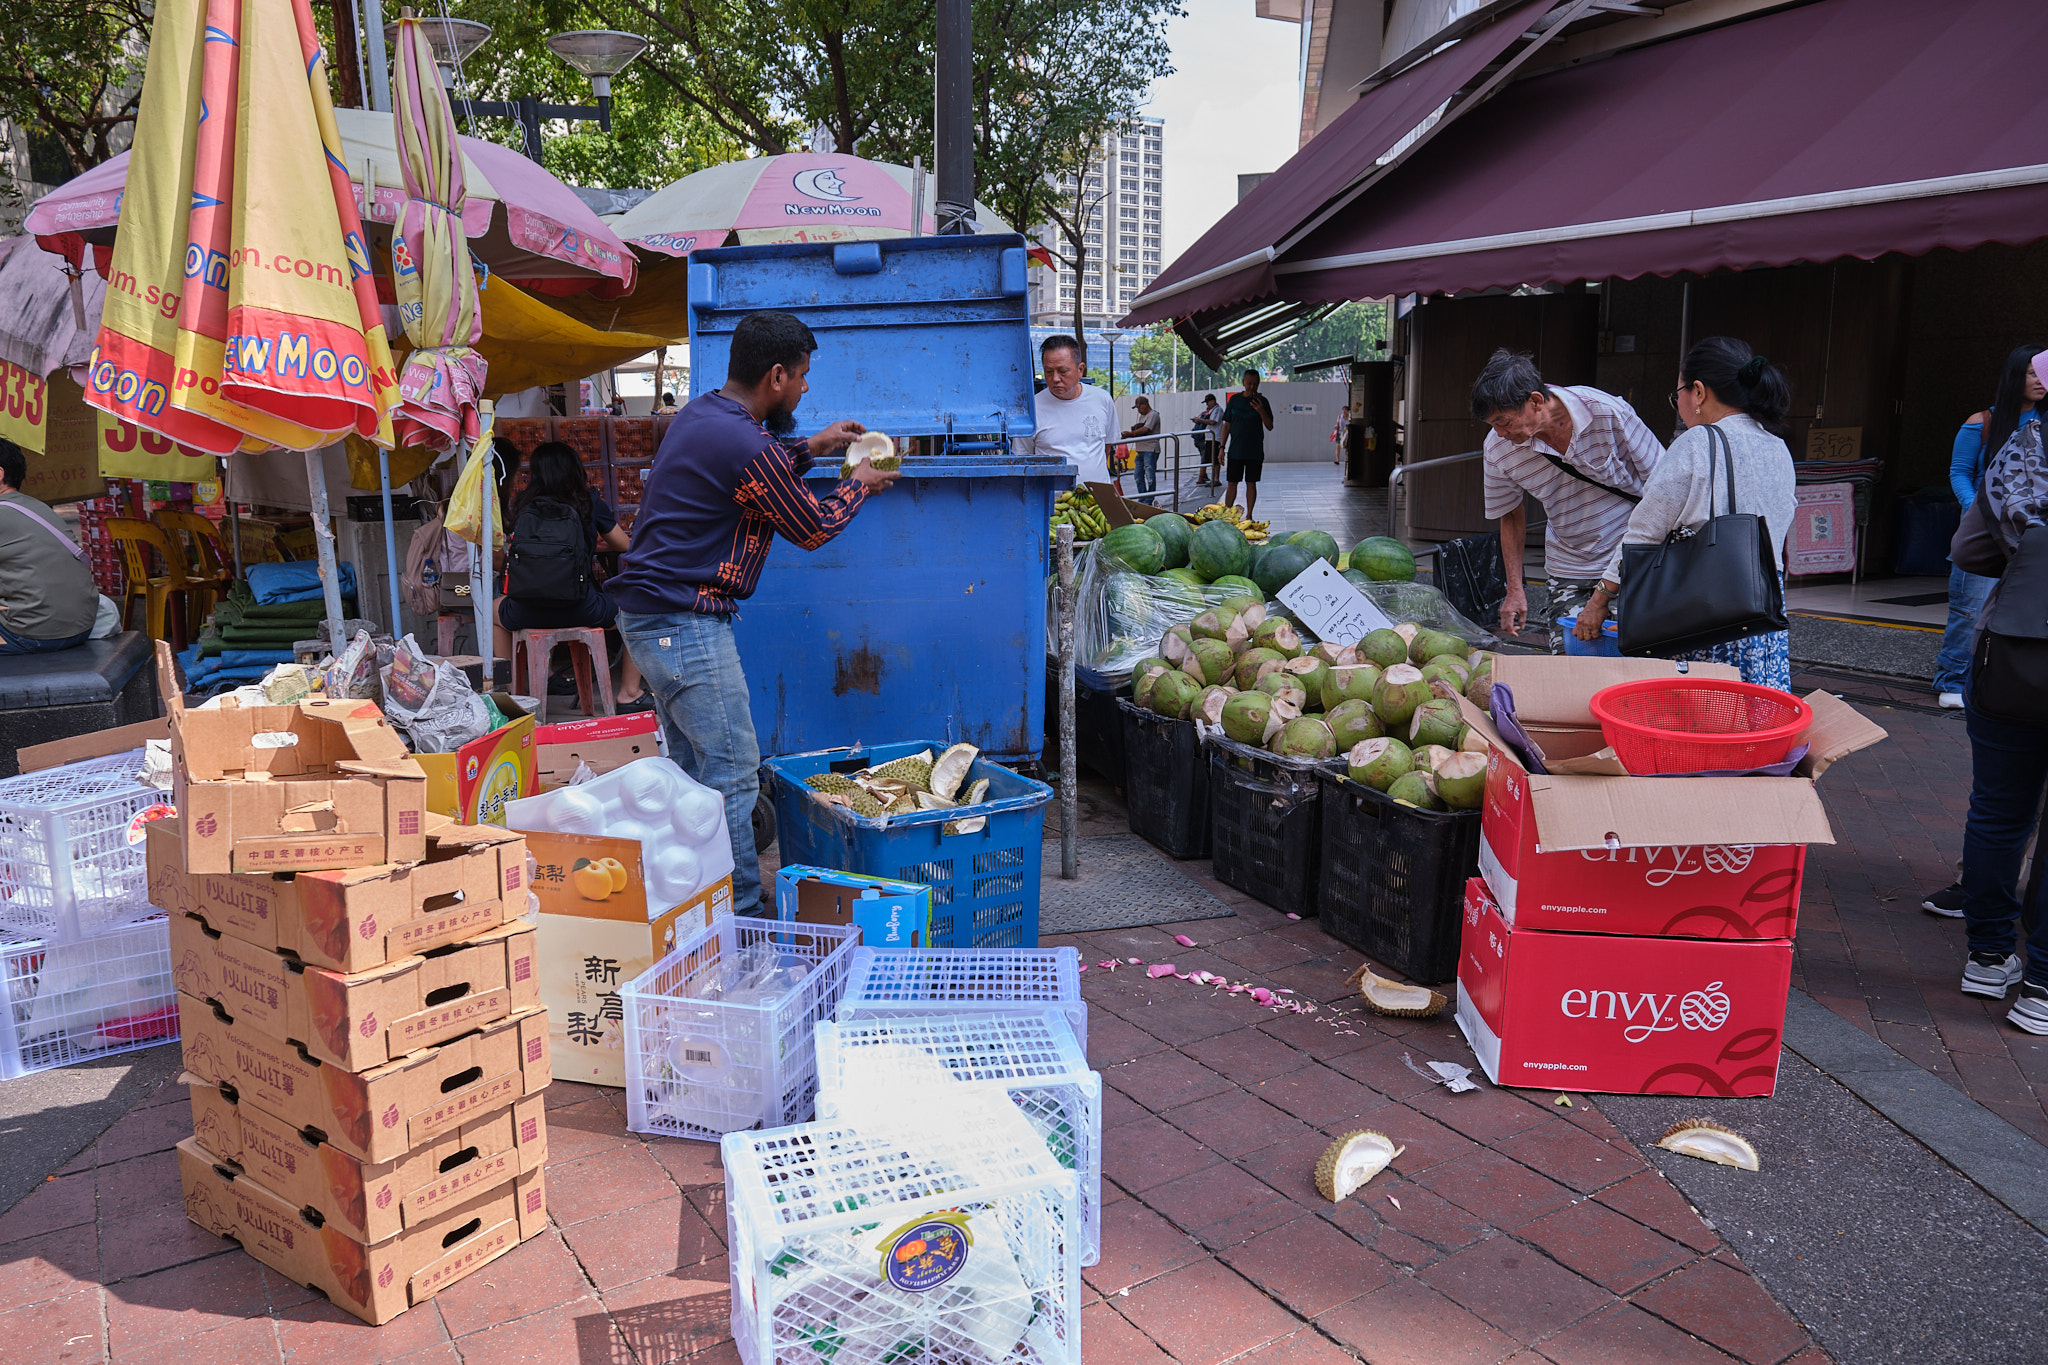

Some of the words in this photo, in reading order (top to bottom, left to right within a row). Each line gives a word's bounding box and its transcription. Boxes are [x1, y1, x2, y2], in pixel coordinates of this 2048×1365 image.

[383, 190, 393, 198] to
[57, 195, 107, 213] Community
[785, 203, 826, 215] New
[828, 204, 881, 216] Moon
[54, 208, 104, 224] Partnership
[1541, 904, 1607, 914] envyapple.com
[1561, 988, 1679, 1043] envy
[1523, 1061, 1588, 1071] envyapple.com
